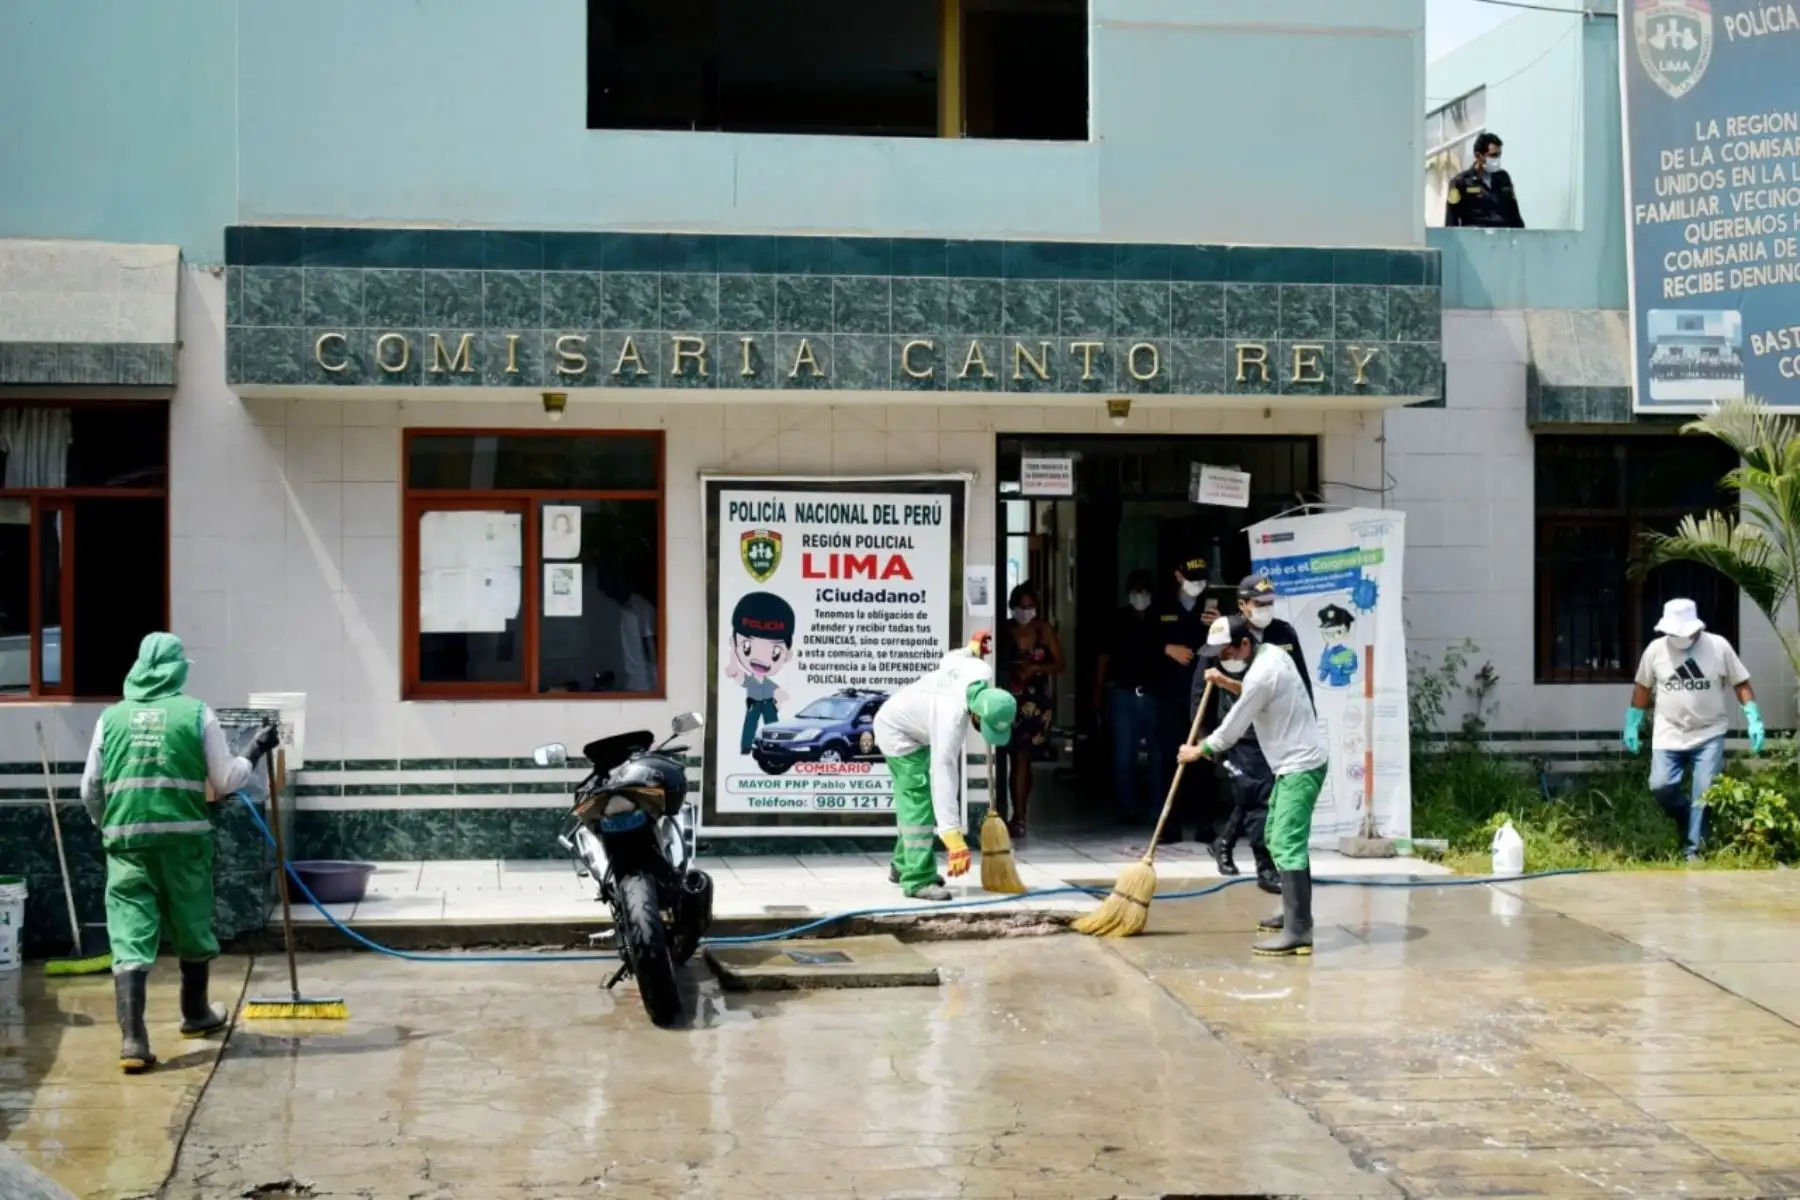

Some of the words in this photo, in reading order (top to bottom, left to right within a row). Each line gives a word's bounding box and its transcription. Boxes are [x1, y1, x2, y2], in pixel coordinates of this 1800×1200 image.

[1696, 119, 1720, 141] LA
[1726, 109, 1798, 137] REGIÓN
[1661, 148, 1684, 171] DE
[1690, 146, 1714, 167] LA
[1655, 169, 1726, 196] UNIDOS
[1731, 165, 1756, 187] EN
[1761, 163, 1786, 184] LA
[1684, 213, 1787, 244] QUEREMOS
[1664, 240, 1768, 273] COMISARIA
[1774, 237, 1797, 258] DE
[1663, 270, 1725, 299] RECIBE
[315, 332, 825, 378] COMISARIA
[901, 339, 1160, 380] CANTO
[1235, 344, 1380, 385] REY
[729, 496, 787, 522] POLICÍA
[795, 502, 868, 524] NACIONAL
[873, 504, 899, 525] DEL
[904, 500, 942, 526] PERÚ
[802, 531, 851, 548] REGIÓN
[855, 535, 915, 549] POLICIAL
[802, 552, 914, 580] LIMA
[816, 588, 926, 604] ¡Ciudadano!
[815, 609, 855, 619] Tenemos
[857, 609, 865, 619] la
[867, 609, 914, 621] obligación
[916, 610, 928, 620] de
[811, 623, 846, 633] atender
[849, 624, 854, 634] y
[856, 623, 886, 633] recibir
[888, 623, 914, 633] todas
[916, 624, 931, 633] tus
[803, 635, 857, 646] DENUNCIAS,
[860, 636, 879, 645] sino
[881, 636, 939, 647] corresponde
[797, 649, 803, 658] a
[805, 649, 825, 658] esta
[876, 650, 888, 659] se
[890, 648, 944, 659] transcribirá
[798, 661, 807, 671] la
[809, 661, 858, 671] ocurrencia
[868, 661, 877, 671] la
[807, 674, 848, 685] POLICIAL
[850, 676, 867, 687] que
[1665, 679, 1711, 691] adidas
[795, 762, 871, 773] COMISARIO
[738, 779, 781, 789] MAYOR
[785, 780, 809, 789] PNP
[813, 779, 845, 789] Pablo
[850, 780, 882, 789] VEGA
[747, 796, 808, 808] Teléfono:
[816, 796, 846, 808] 980
[852, 796, 878, 808] 121
